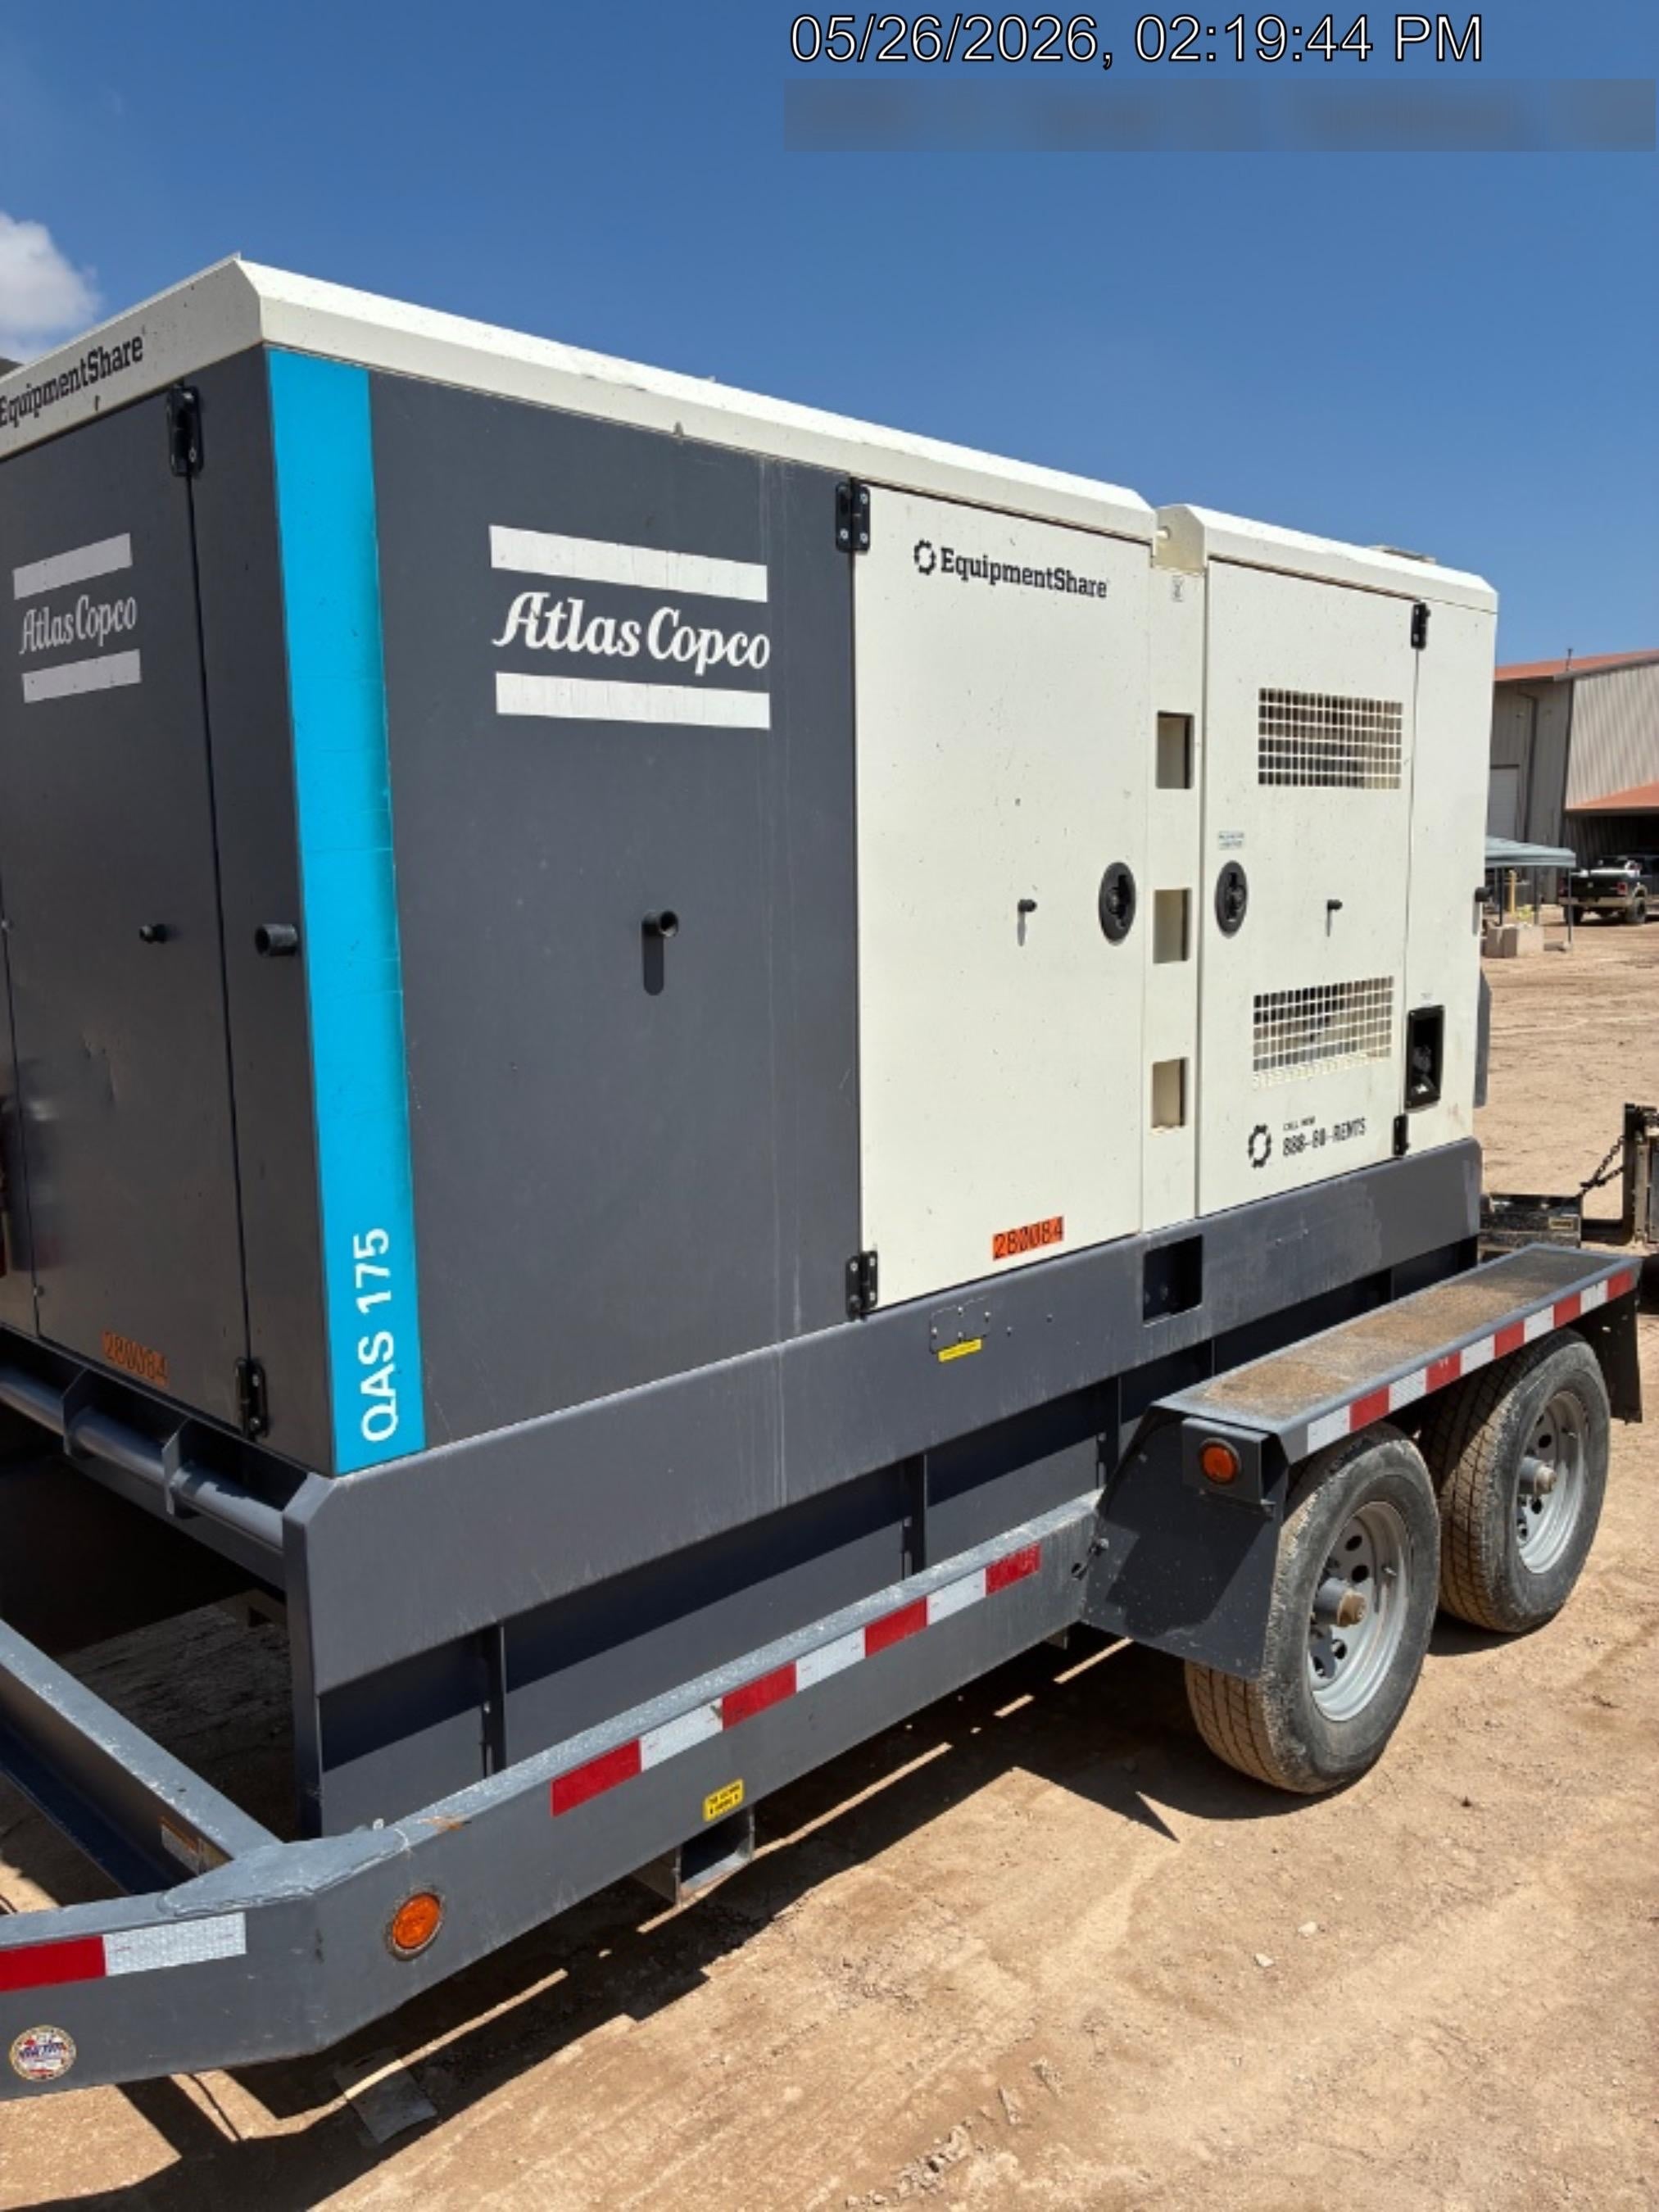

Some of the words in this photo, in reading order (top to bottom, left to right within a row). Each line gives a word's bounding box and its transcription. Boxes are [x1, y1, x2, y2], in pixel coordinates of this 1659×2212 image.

[941, 546, 1107, 598] EquipmentShare
[19, 605, 74, 655] Atlas
[75, 594, 137, 647] Copco
[492, 592, 642, 657] Atlas
[646, 606, 771, 676] Copco
[352, 1228, 392, 1314] 175
[357, 1330, 398, 1441] QAS
